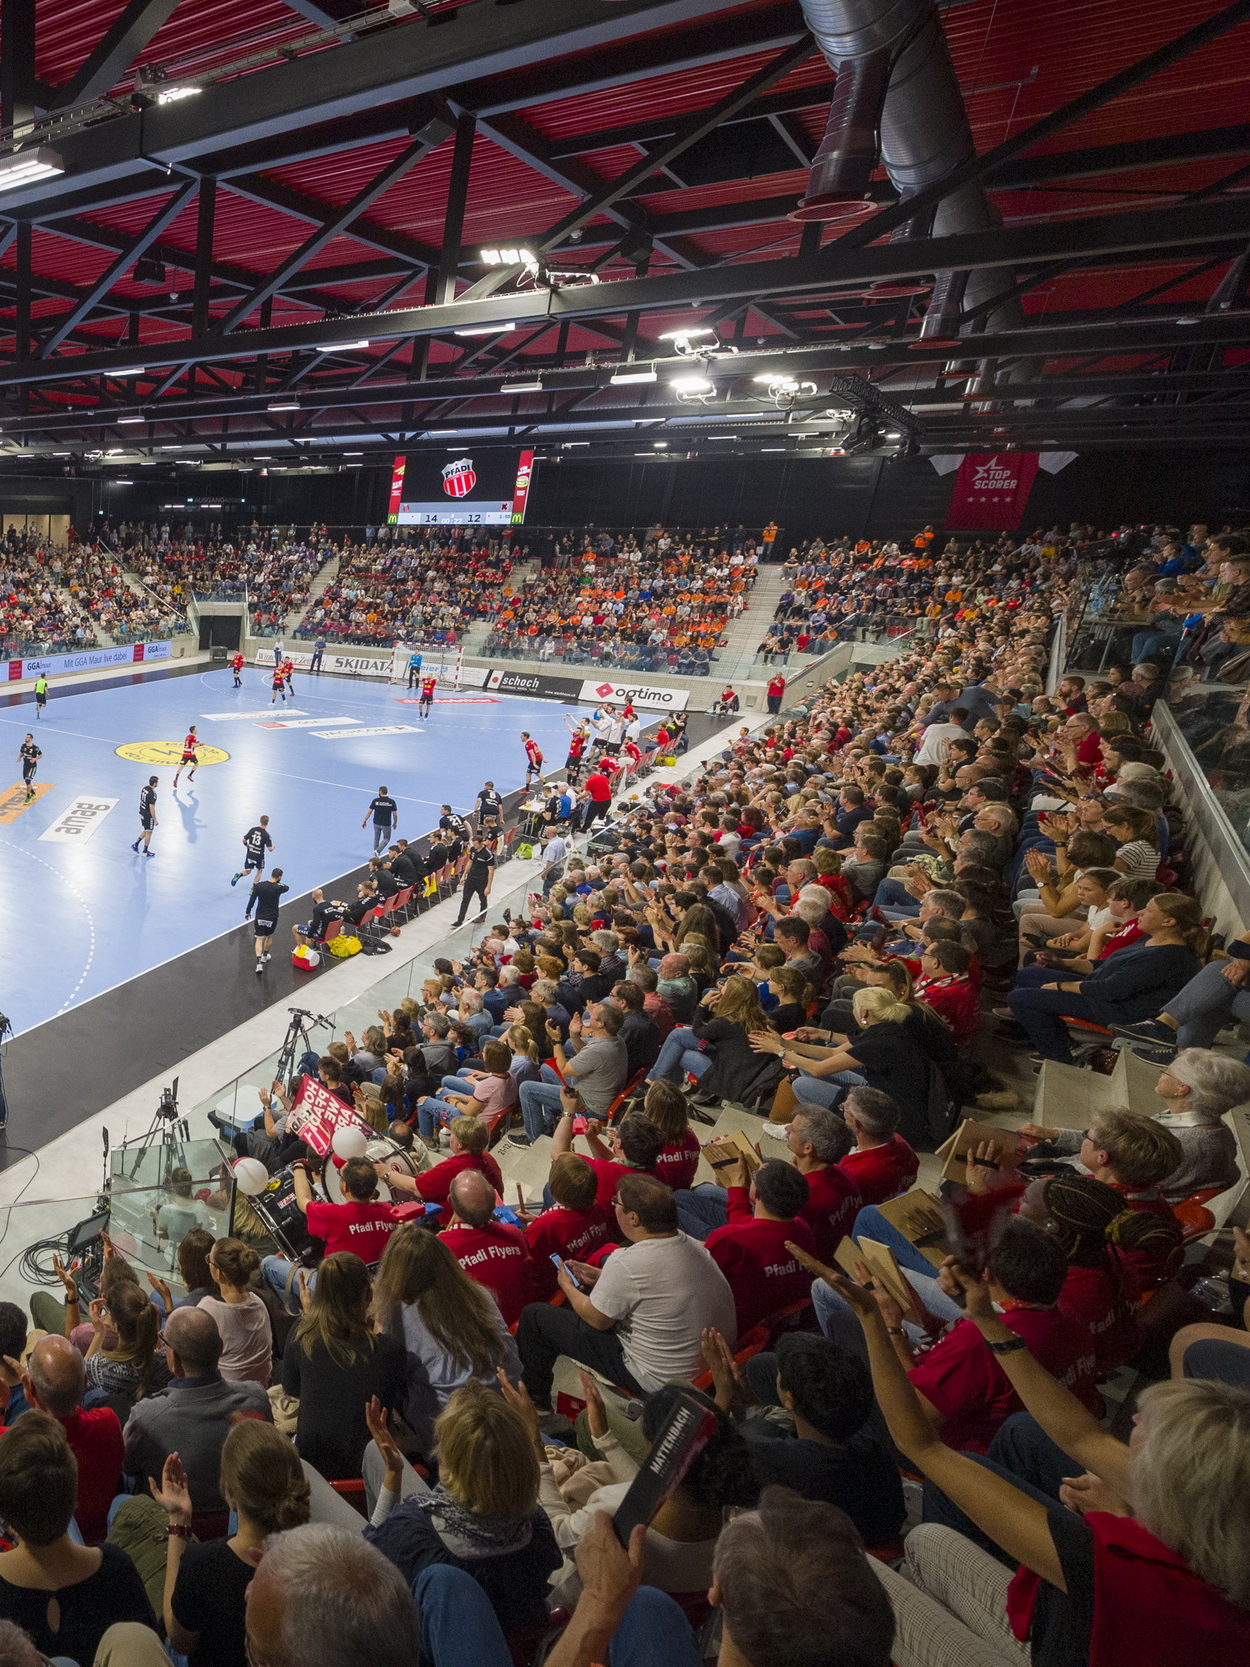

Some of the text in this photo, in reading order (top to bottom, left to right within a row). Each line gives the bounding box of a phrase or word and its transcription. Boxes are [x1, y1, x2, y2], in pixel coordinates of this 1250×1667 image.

[445, 464, 471, 478] PFADI
[989, 470, 1011, 480] TOP
[974, 480, 1018, 489] SCORER
[425, 514, 438, 523] 14
[468, 514, 481, 523] 12
[27, 661, 41, 671] GGA
[64, 659, 74, 669] Mit
[74, 657, 88, 667] GGA
[88, 655, 102, 665] Maur
[103, 653, 113, 663] live
[113, 652, 127, 661] dabei
[334, 657, 393, 671] SKIDATA
[502, 676, 540, 688] schoch
[615, 687, 673, 702] optimo
[251, 834, 262, 846] 13
[656, 1150, 683, 1164] Pfadi
[348, 1219, 399, 1235] Pfadi Flyer
[458, 1245, 522, 1271] Pfadi Flyers
[764, 1260, 796, 1278] Pfadi
[649, 1406, 691, 1474] MATTENBACH
